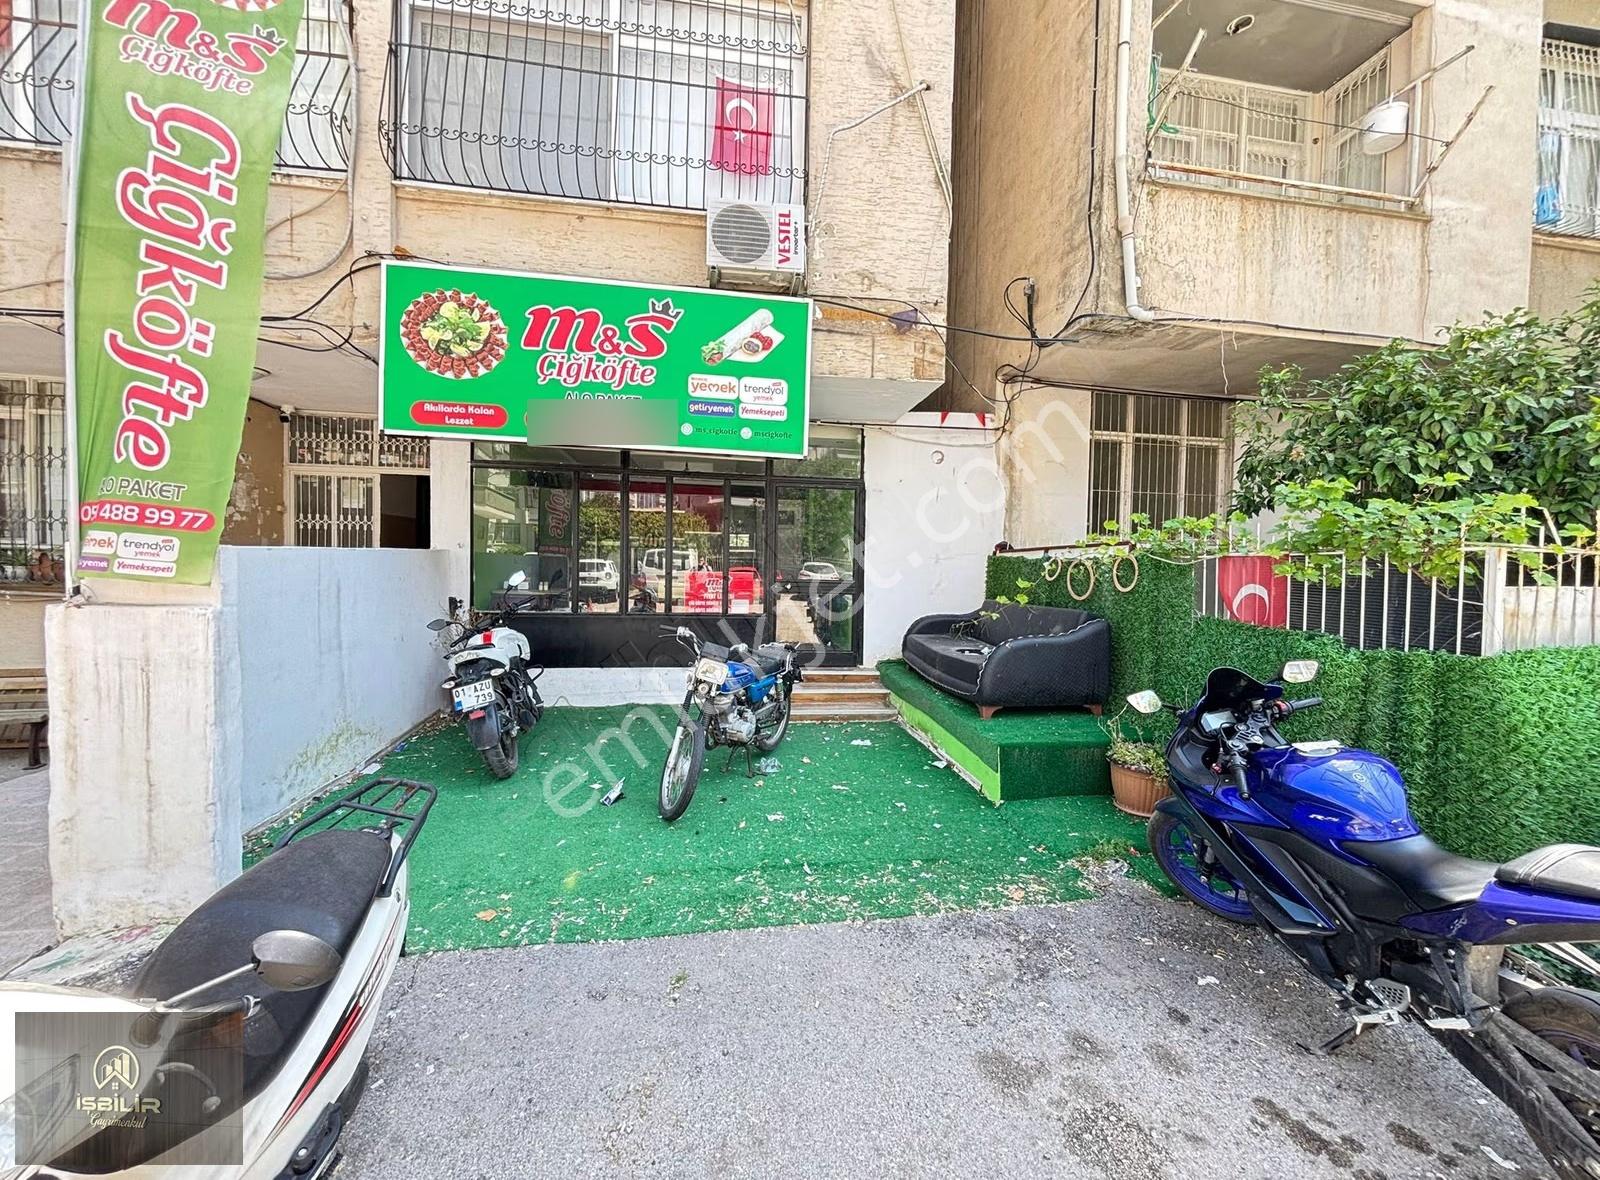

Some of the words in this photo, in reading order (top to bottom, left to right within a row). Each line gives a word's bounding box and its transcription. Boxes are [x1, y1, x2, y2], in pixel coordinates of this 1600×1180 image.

[120, 36, 253, 94] Çiğköfte
[778, 209, 791, 264] VESTEL
[107, 95, 239, 468] Çiğköfte
[537, 354, 656, 389] Çiğköfte
[744, 383, 784, 396] trendyol
[467, 405, 495, 415] Kalan
[689, 404, 733, 413] getiryemek
[740, 406, 785, 417] Yemeksepeti
[444, 415, 474, 425] Lezzet
[117, 478, 186, 500] PAKET
[144, 508, 176, 527] 99
[178, 511, 209, 529] 77
[122, 538, 176, 552] trendyol
[117, 561, 174, 573] Yemeksepeti
[454, 688, 466, 699] 01
[473, 681, 491, 694] AZU
[474, 692, 493, 704] 739
